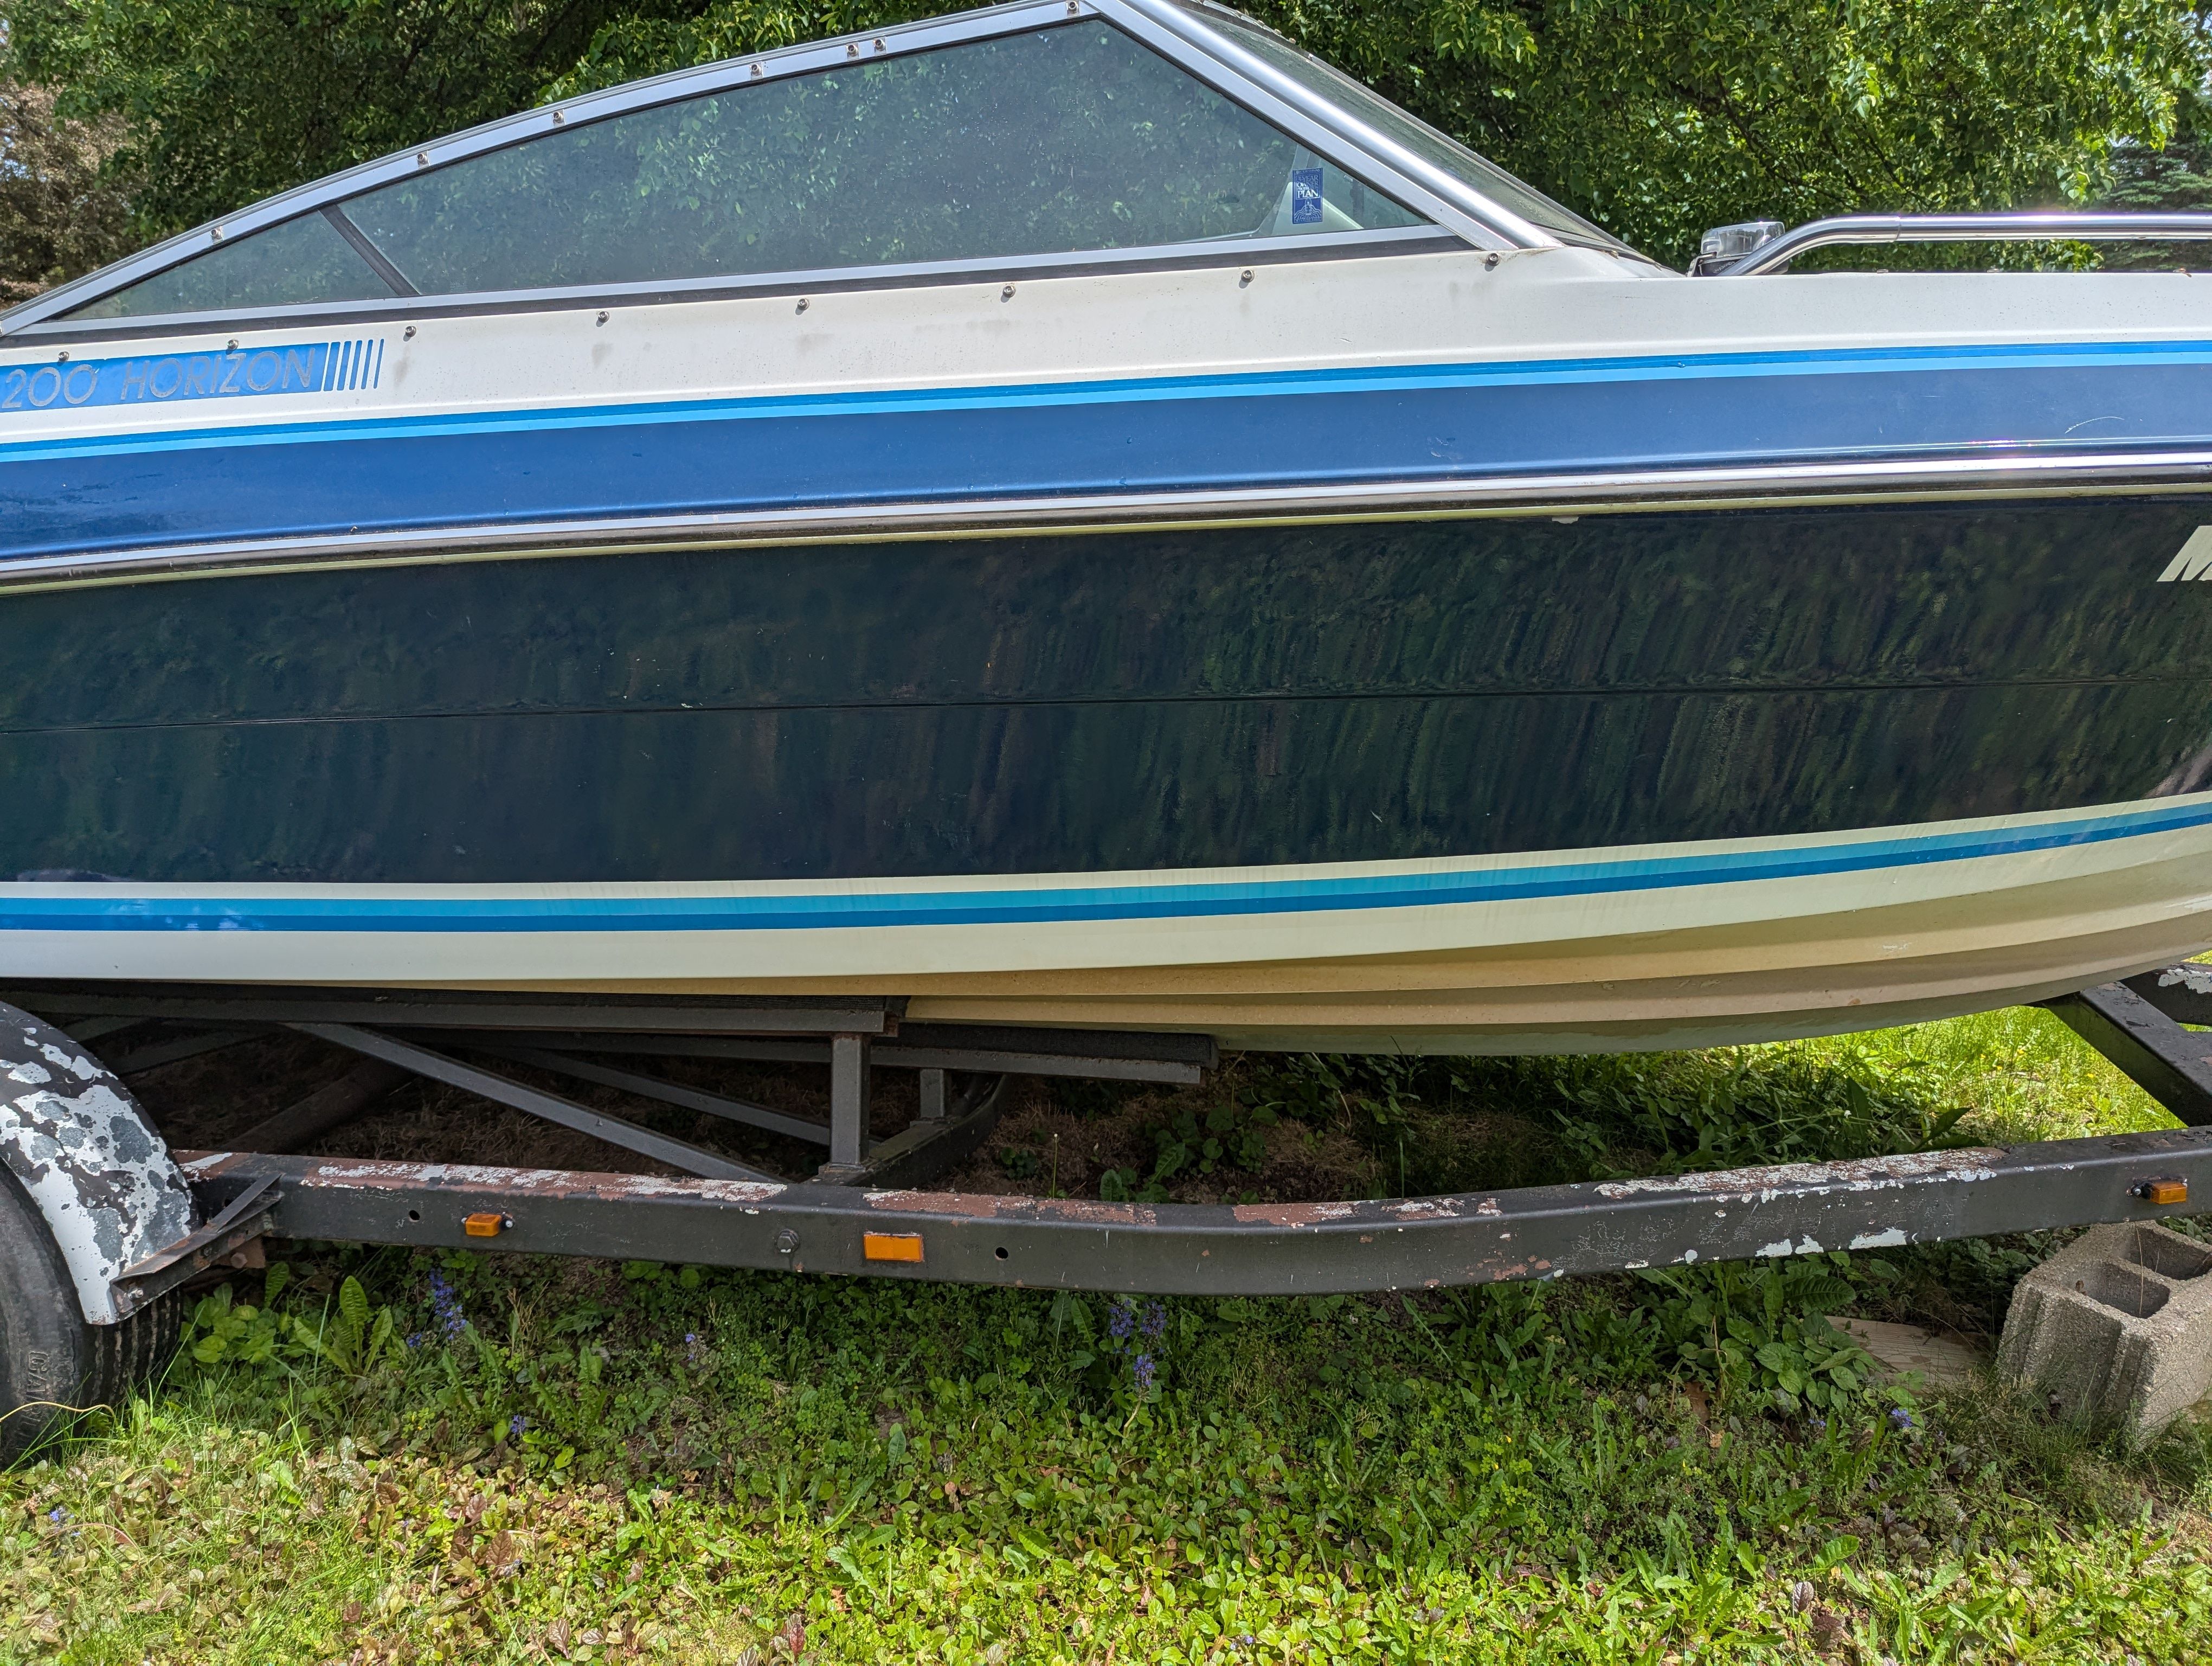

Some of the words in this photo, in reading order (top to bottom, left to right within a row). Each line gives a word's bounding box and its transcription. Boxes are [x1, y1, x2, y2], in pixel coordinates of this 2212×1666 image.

[1297, 189, 1319, 198] PLAN
[2, 364, 98, 408] 200
[120, 347, 316, 400] HORIZON
